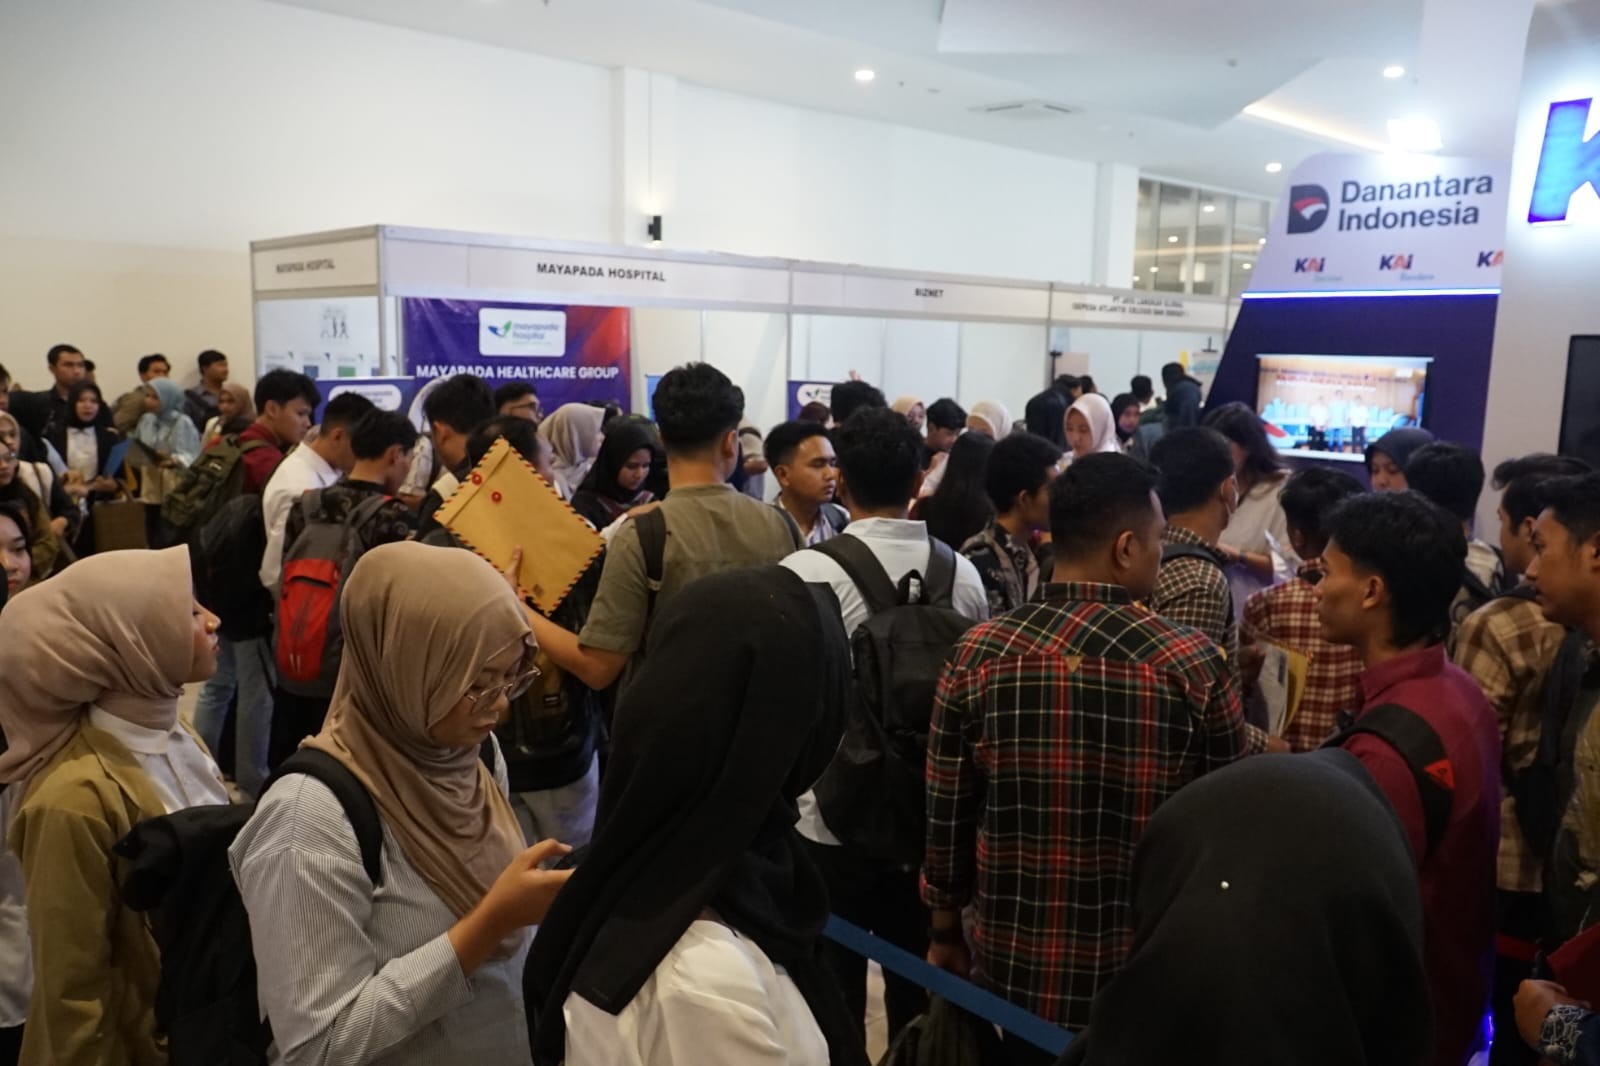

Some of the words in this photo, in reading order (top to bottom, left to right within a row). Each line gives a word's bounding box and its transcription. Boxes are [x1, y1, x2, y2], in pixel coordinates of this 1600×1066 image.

[1341, 174, 1493, 204] Danantara
[1337, 201, 1479, 232] Indonesia
[536, 262, 604, 277] MAYAPADA
[608, 267, 666, 282] HOSPITAL
[416, 365, 495, 379] MAYAPADA
[496, 366, 577, 379] HEALTHCARE
[578, 366, 620, 379] GROUP
